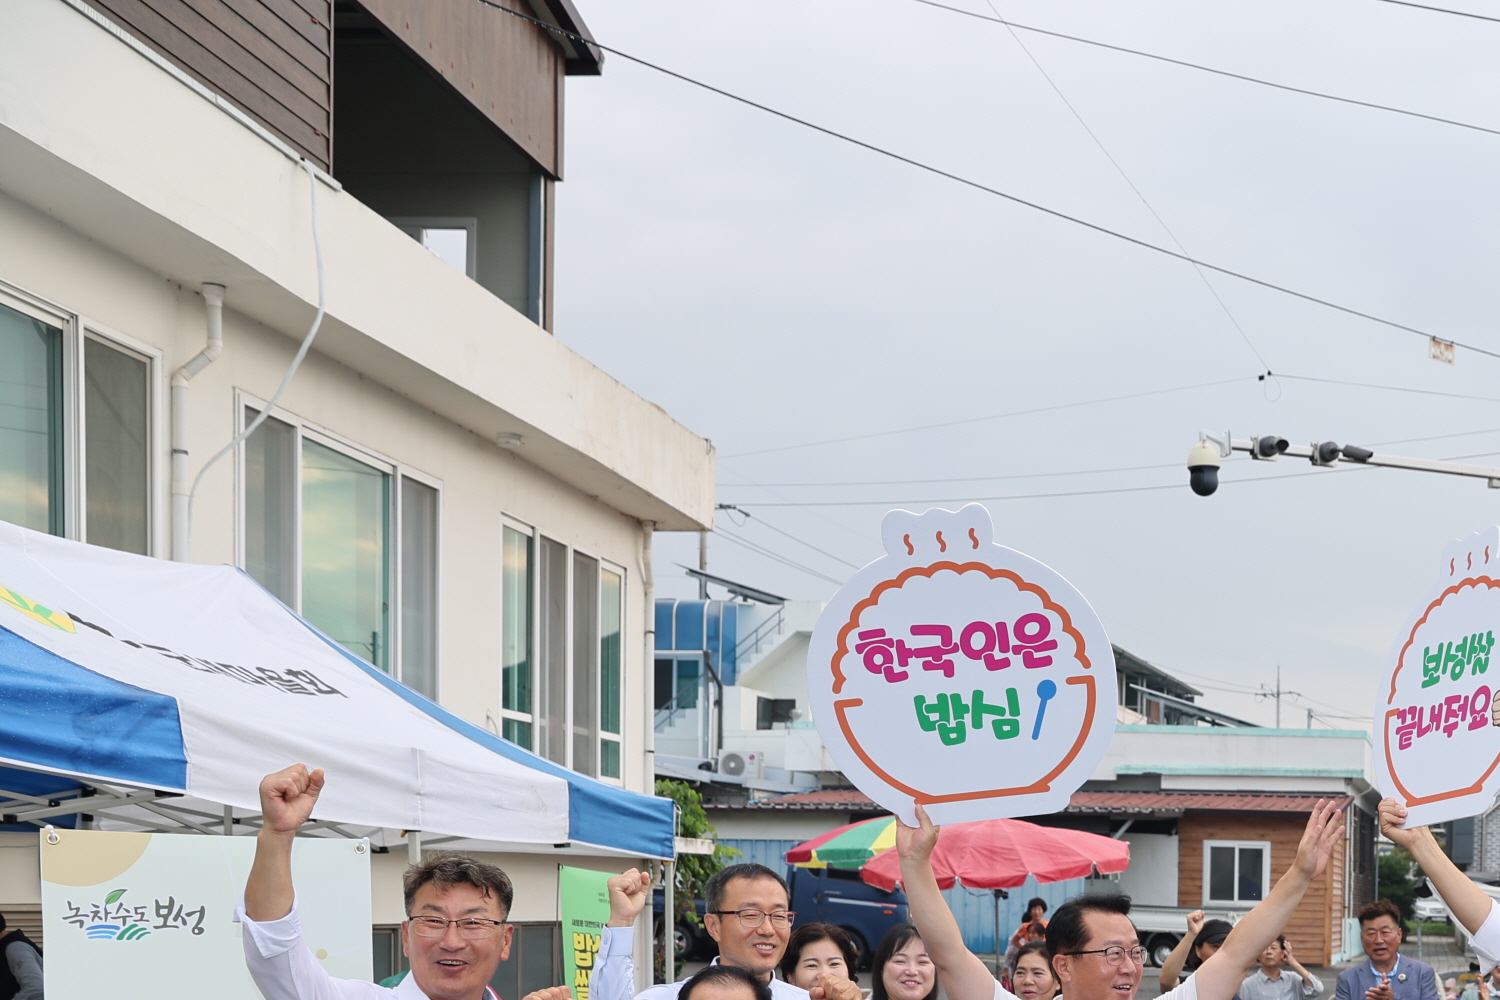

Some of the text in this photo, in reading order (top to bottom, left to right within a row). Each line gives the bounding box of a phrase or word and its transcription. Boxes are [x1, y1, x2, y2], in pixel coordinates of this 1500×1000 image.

[854, 612, 1058, 683] 한국인은
[1421, 630, 1495, 689] 보성쌀
[913, 687, 1021, 746] 밥심
[1395, 685, 1492, 751] 끝내줘요
[61, 896, 206, 936] 녹차수도 보성
